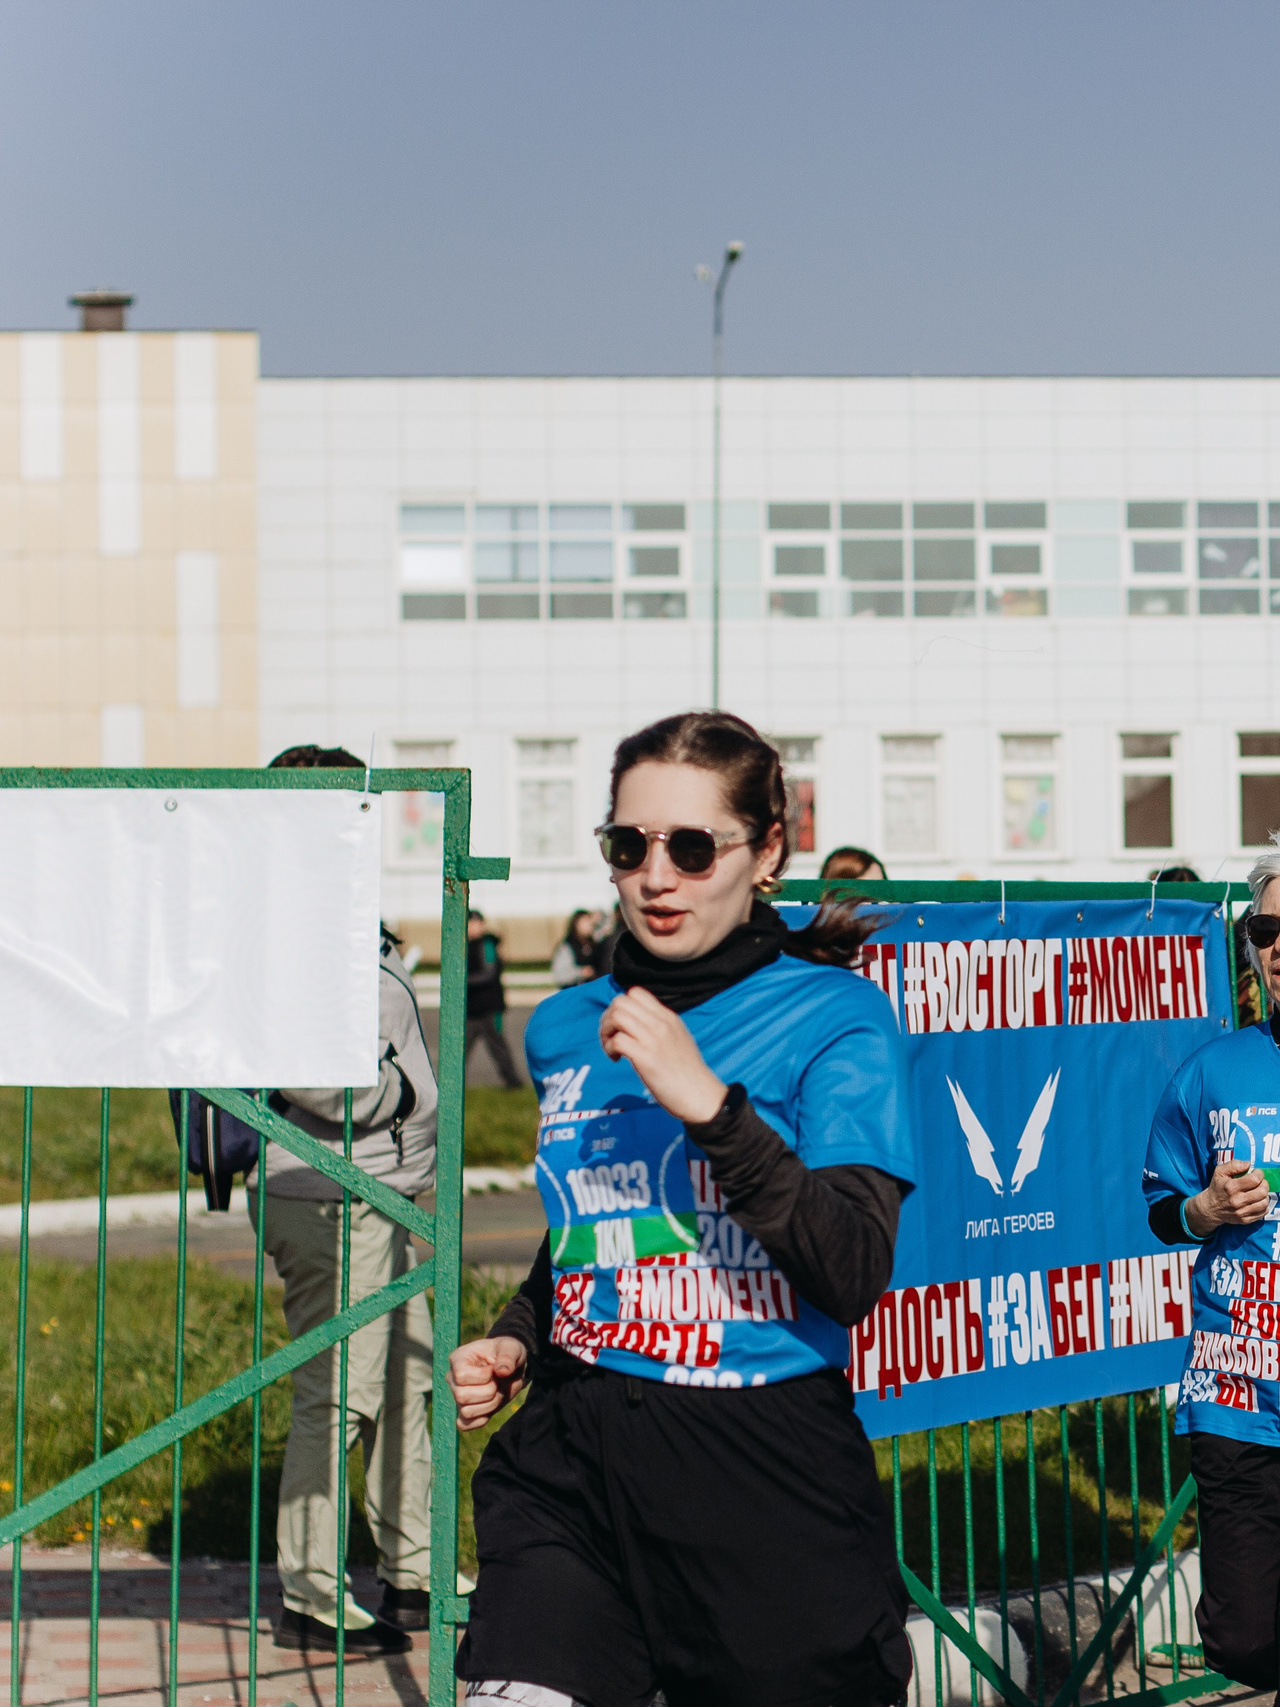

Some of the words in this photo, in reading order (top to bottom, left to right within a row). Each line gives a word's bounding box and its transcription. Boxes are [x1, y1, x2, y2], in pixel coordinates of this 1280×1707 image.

[902, 938, 1062, 1034] #ВОСТОРГ
[1066, 935, 1208, 1024] #МОМЕНТ
[1258, 1107, 1277, 1115] ПСБ
[566, 1160, 652, 1216] 10033
[965, 1217, 1000, 1239] ЛИГА
[1003, 1211, 1055, 1235] ГЕРОЕВ
[844, 1278, 985, 1400] РДОСТЬ
[988, 1263, 1105, 1369] #ЗАБЕГ
[1107, 1249, 1199, 1348] #МЕЧ
